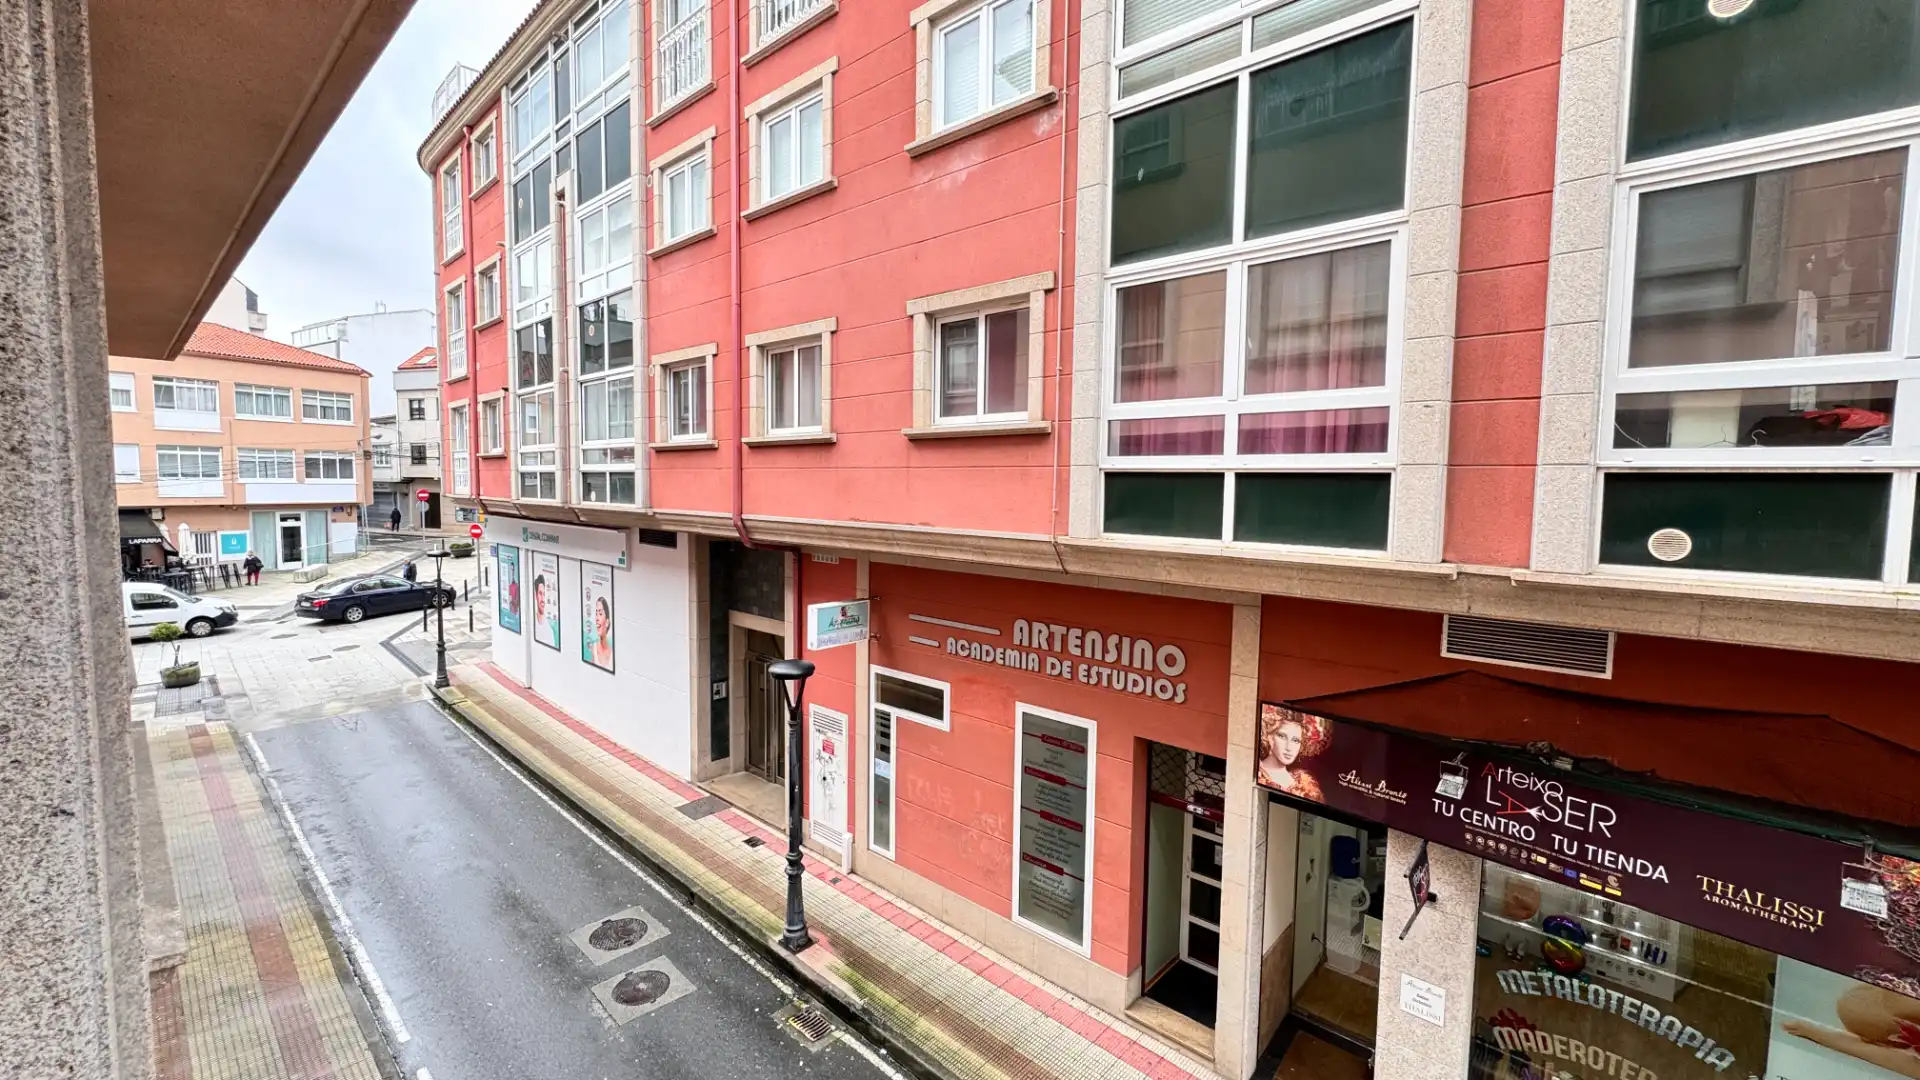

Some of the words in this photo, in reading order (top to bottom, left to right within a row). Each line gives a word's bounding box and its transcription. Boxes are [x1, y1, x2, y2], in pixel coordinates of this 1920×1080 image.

[946, 637, 1040, 673] ACADEMIA
[1046, 656, 1072, 680] DE
[1078, 663, 1186, 704] ESTUDIOS
[1013, 618, 1186, 677] ARTENSINO
[1481, 762, 1564, 798] Arteixo
[1486, 775, 1616, 839] LASER
[1432, 798, 1455, 818] TU
[1460, 810, 1536, 842] CENTRO
[1551, 833, 1578, 856] TU
[1584, 844, 1669, 884] TIENDA
[1696, 874, 1826, 927] THALISSI
[1703, 893, 1818, 933] AROMATHERAPY
[1496, 968, 1736, 1072] METALOTERAPIA
